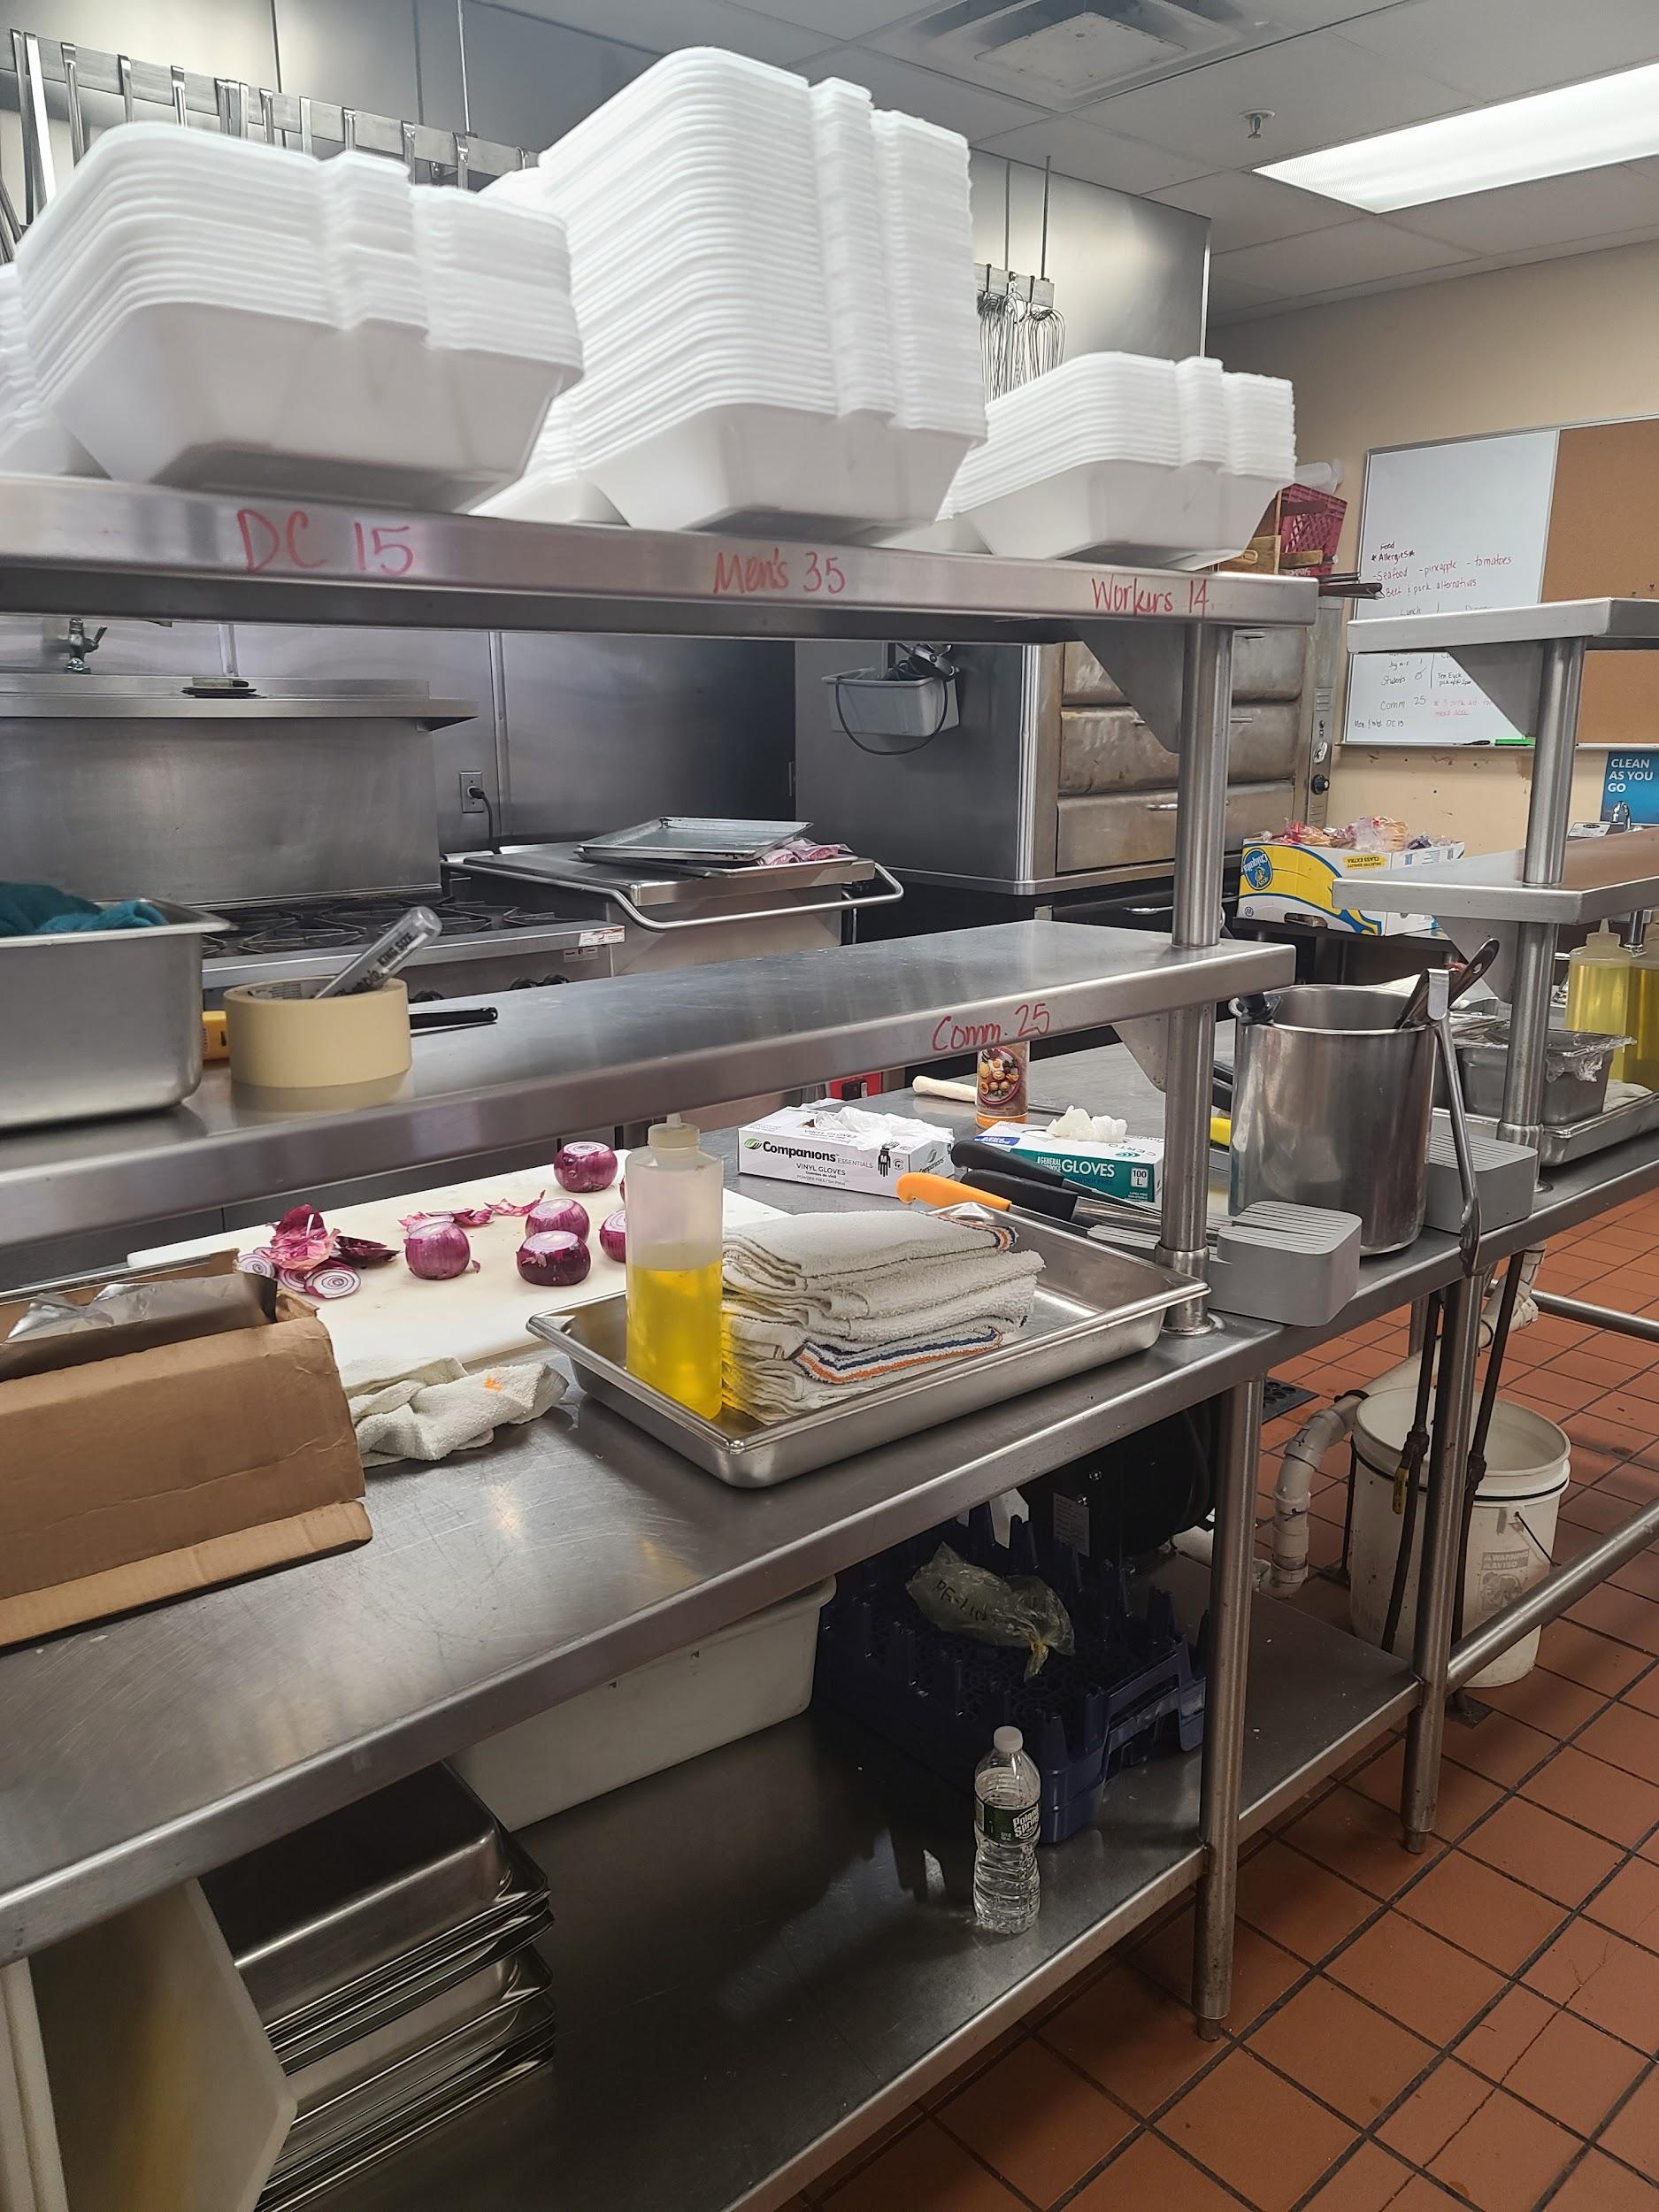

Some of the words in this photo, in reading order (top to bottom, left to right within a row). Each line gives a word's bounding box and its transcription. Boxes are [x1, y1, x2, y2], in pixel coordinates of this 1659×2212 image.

[237, 508, 326, 574] DC
[353, 518, 415, 578] 15
[1379, 541, 1395, 550] Food
[712, 547, 790, 595] Men's
[802, 551, 846, 595] 35
[1380, 701, 1406, 710] Comm
[1414, 695, 1426, 705] 25
[1611, 758, 1650, 768] CLEAN
[1609, 771, 1624, 780] AS
[1627, 772, 1654, 780] YOU
[1608, 782, 1626, 792] GO
[1243, 853, 1268, 872] Chiquita
[376, 948, 399, 967] KING
[1014, 1002, 1051, 1038] 25
[796, 1163, 817, 1172] VINYL
[818, 1164, 846, 1176] GLOVES
[837, 1157, 874, 1169] ESSENTIALS
[1061, 1159, 1115, 1177] GLOVES
